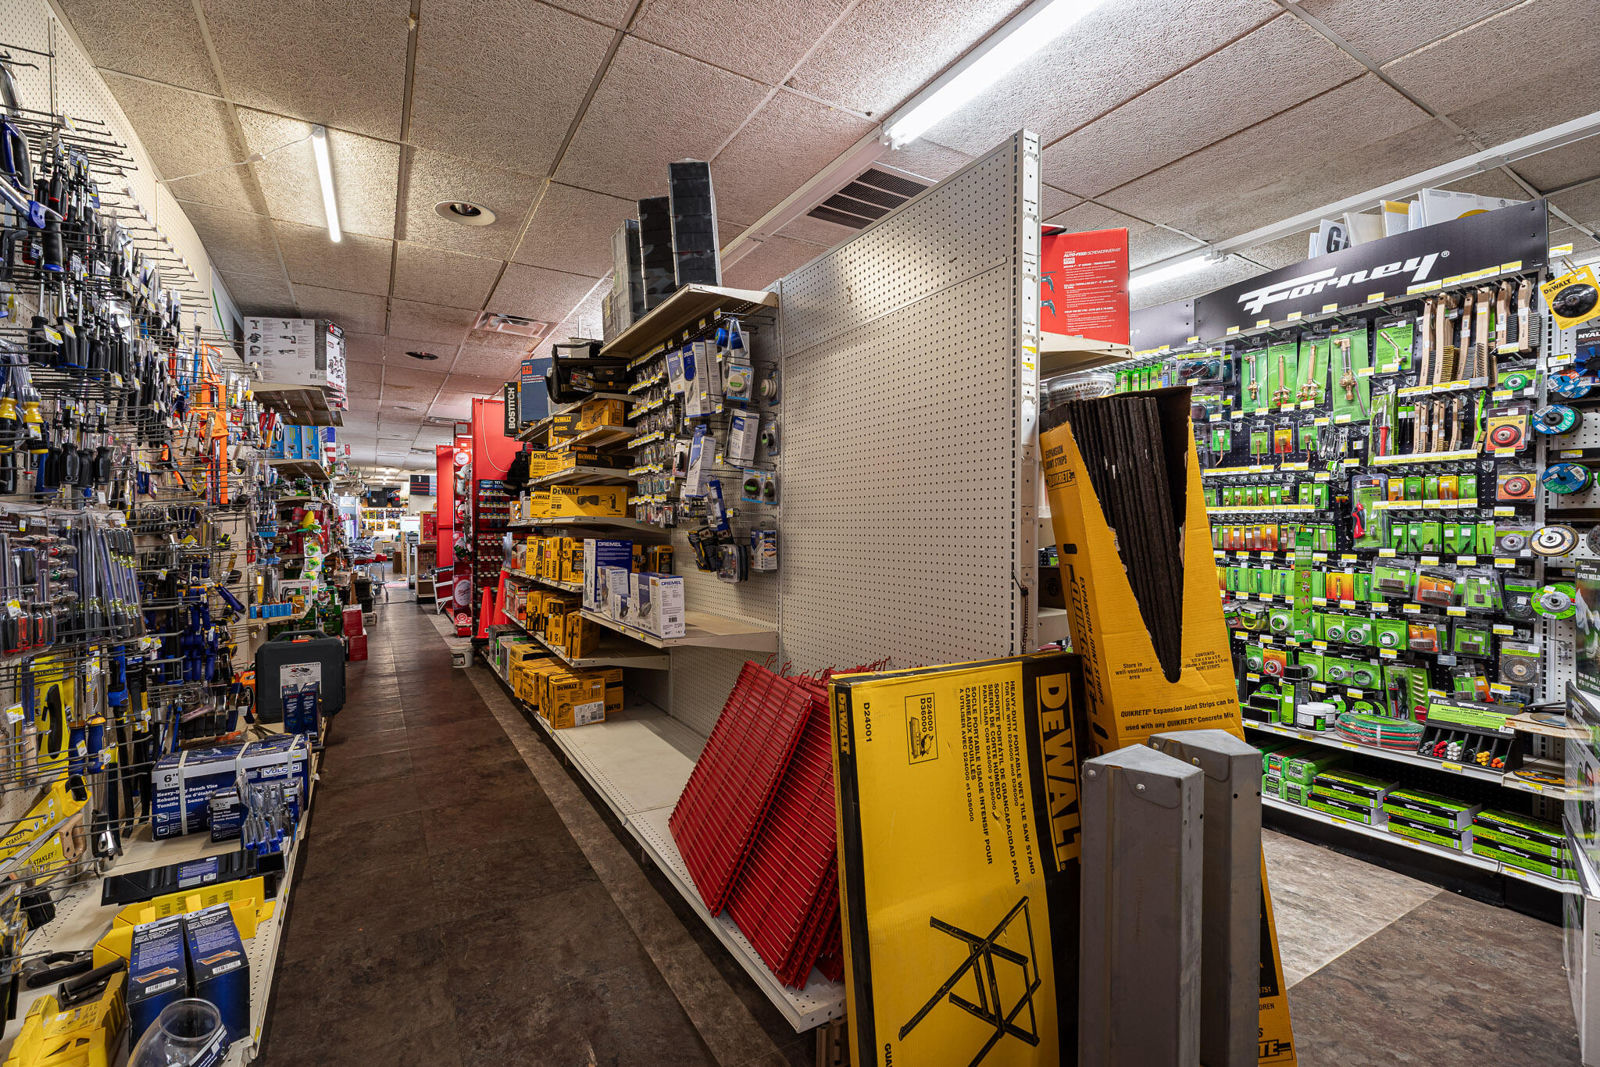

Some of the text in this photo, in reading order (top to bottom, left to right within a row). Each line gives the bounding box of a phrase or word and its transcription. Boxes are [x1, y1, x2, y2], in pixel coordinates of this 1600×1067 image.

[1080, 576, 1093, 634] EXPANSION
[1116, 666, 1152, 676] well-ventilated
[926, 697, 934, 732] D24000
[1010, 680, 1018, 732] HEAVY-DUTY
[1153, 706, 1182, 715] Expansion
[1199, 702, 1215, 710] Strips
[1198, 714, 1222, 723] Concrete
[864, 702, 872, 743] D24001
[989, 717, 995, 728] DE
[968, 736, 976, 781] MOUILLES
[990, 731, 998, 760] CORTE
[1013, 734, 1022, 779] PORTABLE
[265, 766, 298, 775] VULCN
[1000, 768, 1006, 781] DE
[966, 783, 970, 791] et
[976, 764, 984, 794] USAGE
[980, 796, 989, 836] INTENSIF
[985, 838, 993, 865] POUR
[1001, 782, 1016, 858] GRANCAPACIDAD
[1012, 860, 1020, 885] PARA
[1026, 845, 1036, 875] STAND
